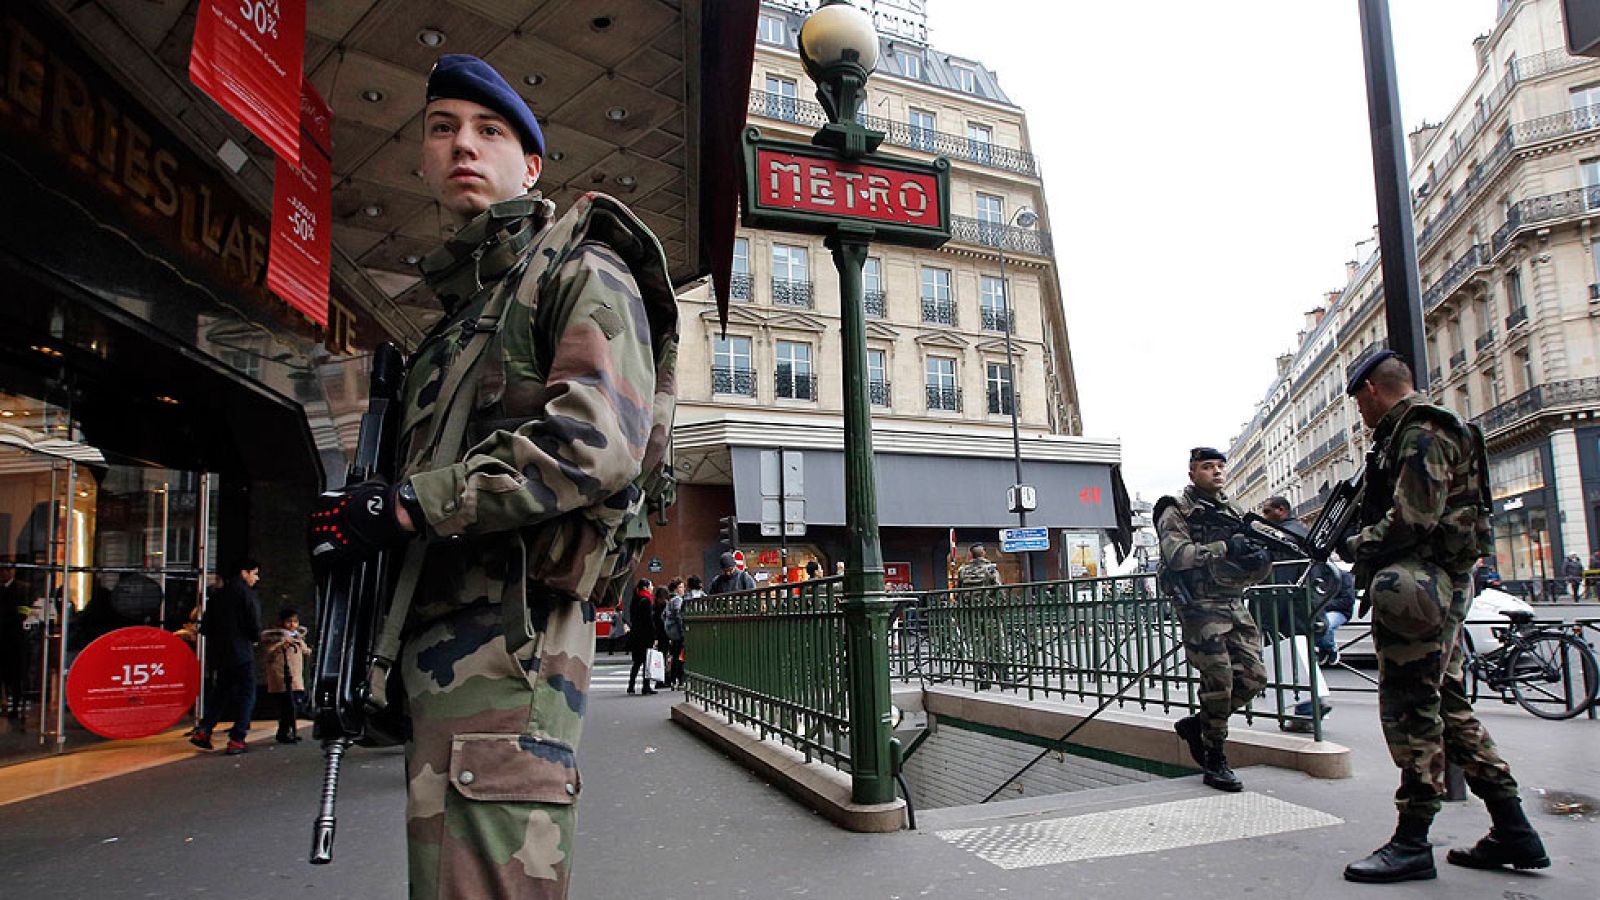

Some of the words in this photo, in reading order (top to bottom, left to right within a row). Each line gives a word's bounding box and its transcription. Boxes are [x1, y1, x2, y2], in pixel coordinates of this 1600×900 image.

[769, 160, 928, 217] METRO
[288, 211, 315, 241] -50%
[111, 663, 165, 686] -15%
